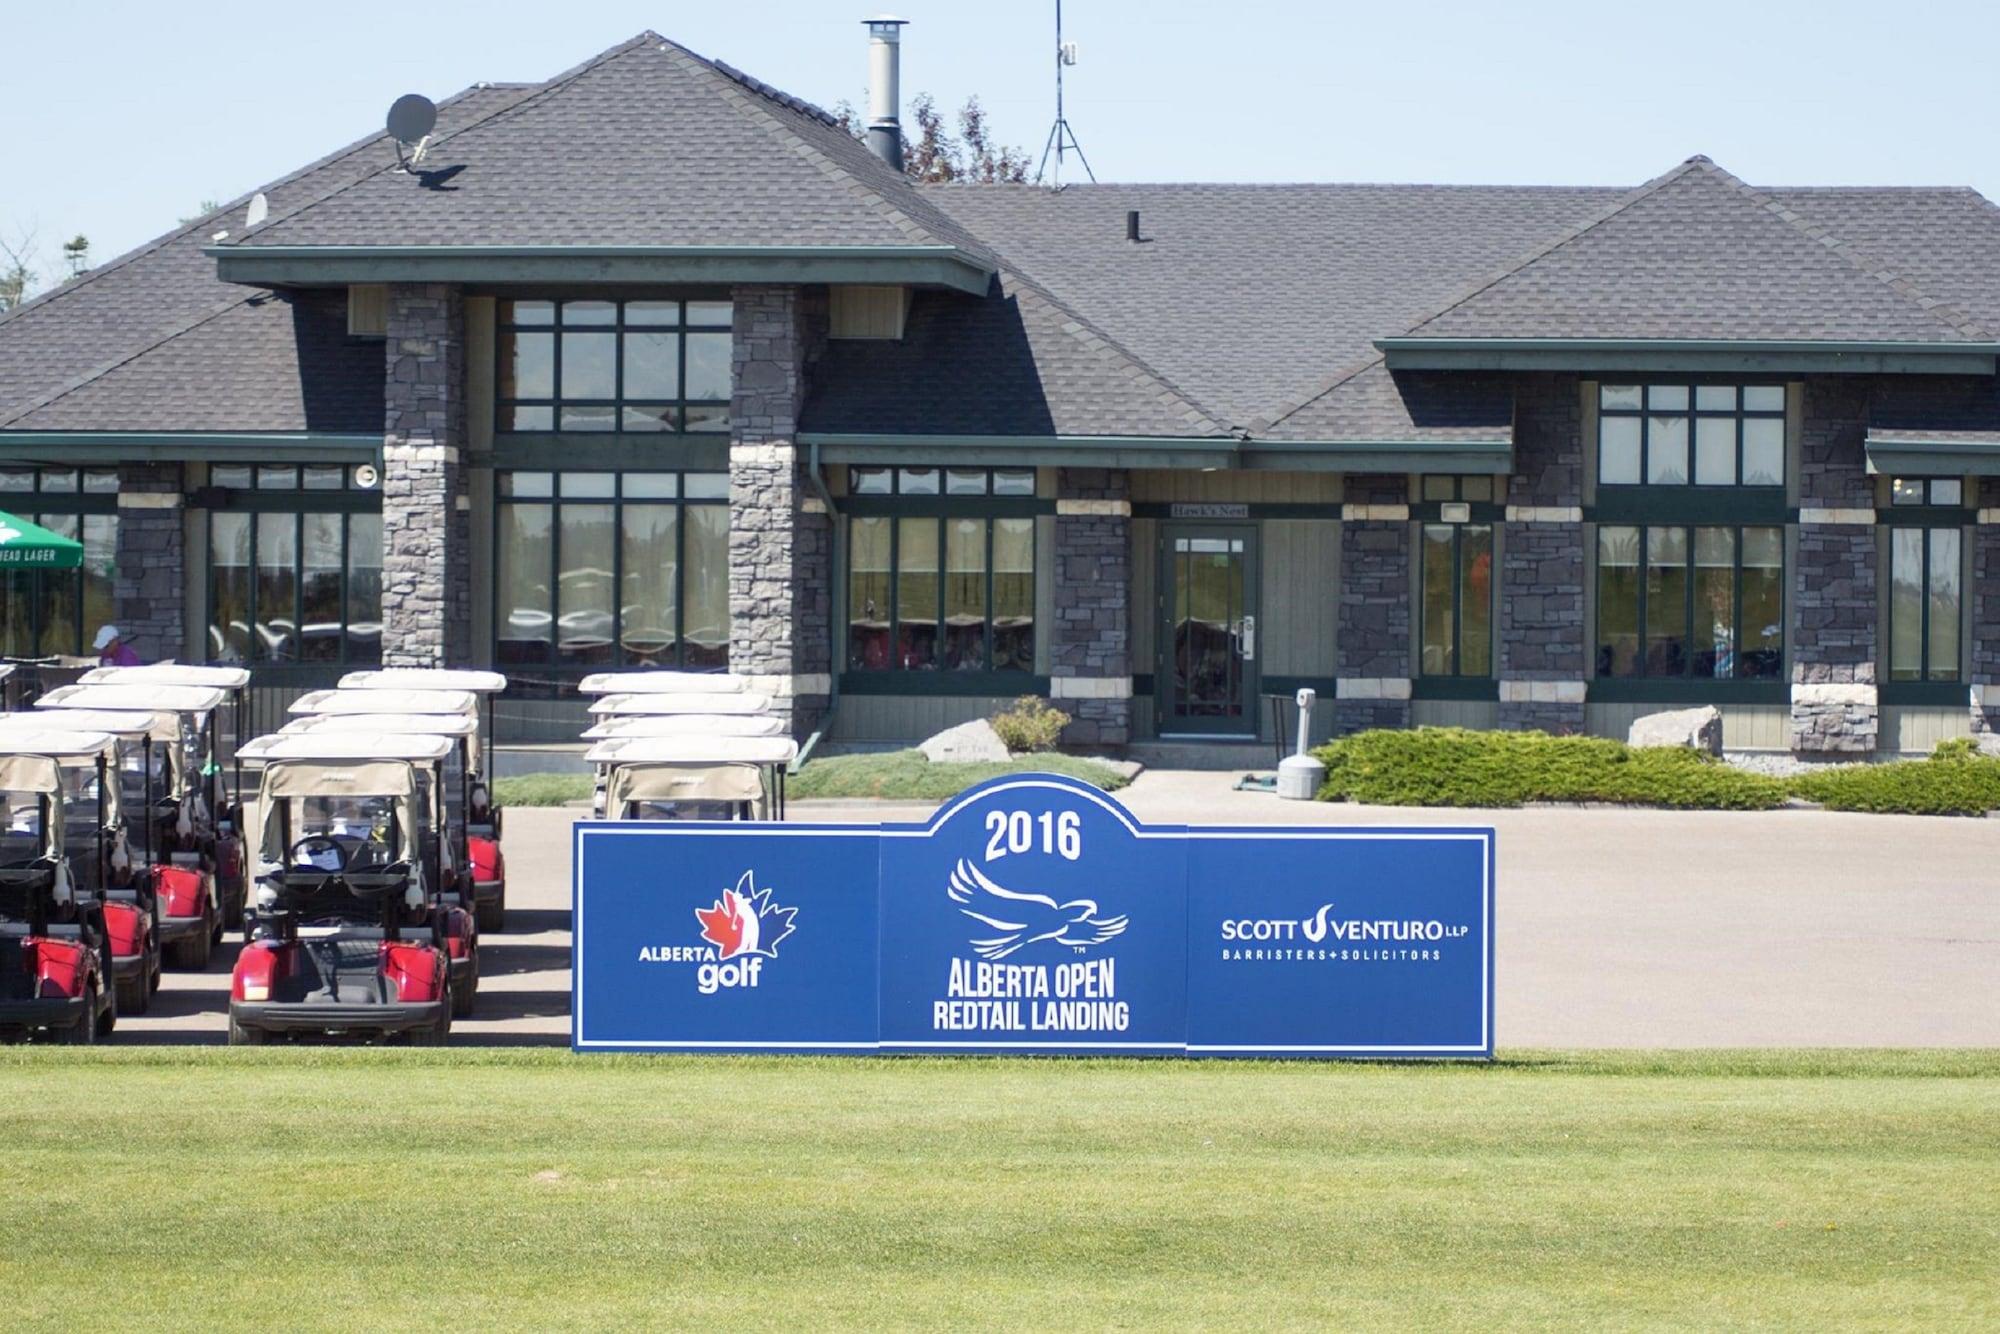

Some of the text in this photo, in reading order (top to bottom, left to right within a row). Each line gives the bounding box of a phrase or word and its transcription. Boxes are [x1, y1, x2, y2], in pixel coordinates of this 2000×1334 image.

[1219, 505, 1246, 516] Nest
[24, 549, 56, 562] LAGER
[985, 810, 1081, 862] 2016
[1221, 919, 1469, 940] SCOTT VENTURO LLP
[639, 946, 716, 962] ALBERTA
[1073, 946, 1086, 954] TM
[697, 957, 763, 994] golf
[948, 957, 1115, 998] ALBERTA OPEN
[933, 1001, 1130, 1031] REDTAIL LANDING
